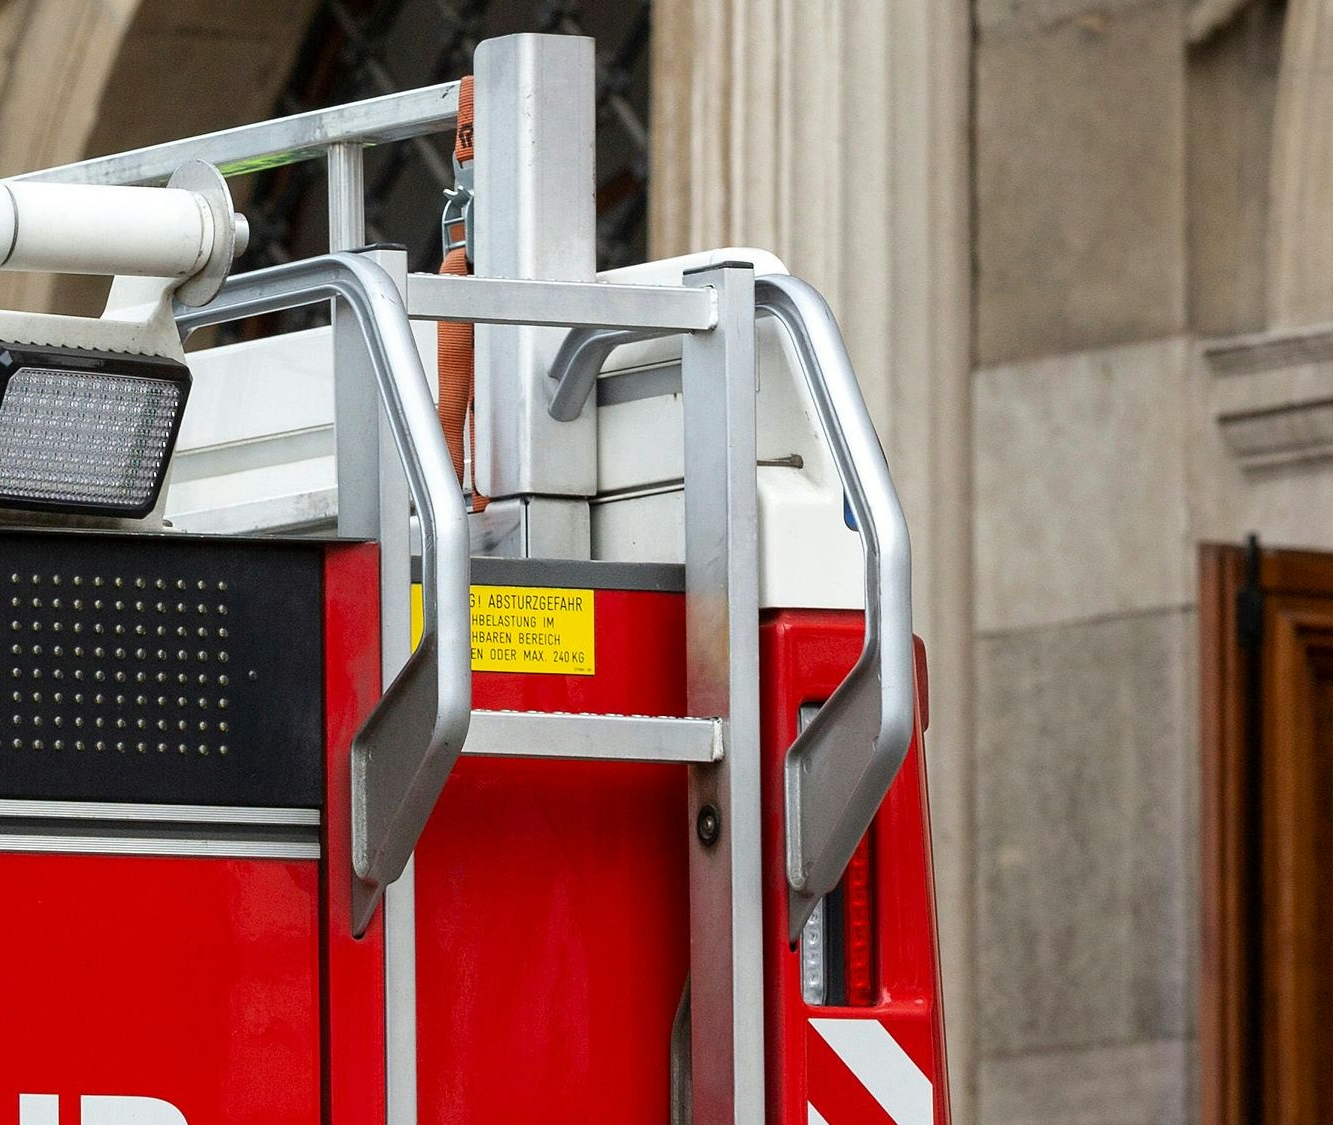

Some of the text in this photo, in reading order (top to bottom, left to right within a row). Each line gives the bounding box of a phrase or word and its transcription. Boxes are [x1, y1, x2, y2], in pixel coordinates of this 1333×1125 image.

[470, 594, 583, 612] G! ABSTURZGEFAHR
[471, 614, 555, 628] HBELASTUNG IM
[471, 631, 561, 646] HBAREN BEREICH
[471, 648, 483, 660] EN
[490, 649, 517, 661] ODER
